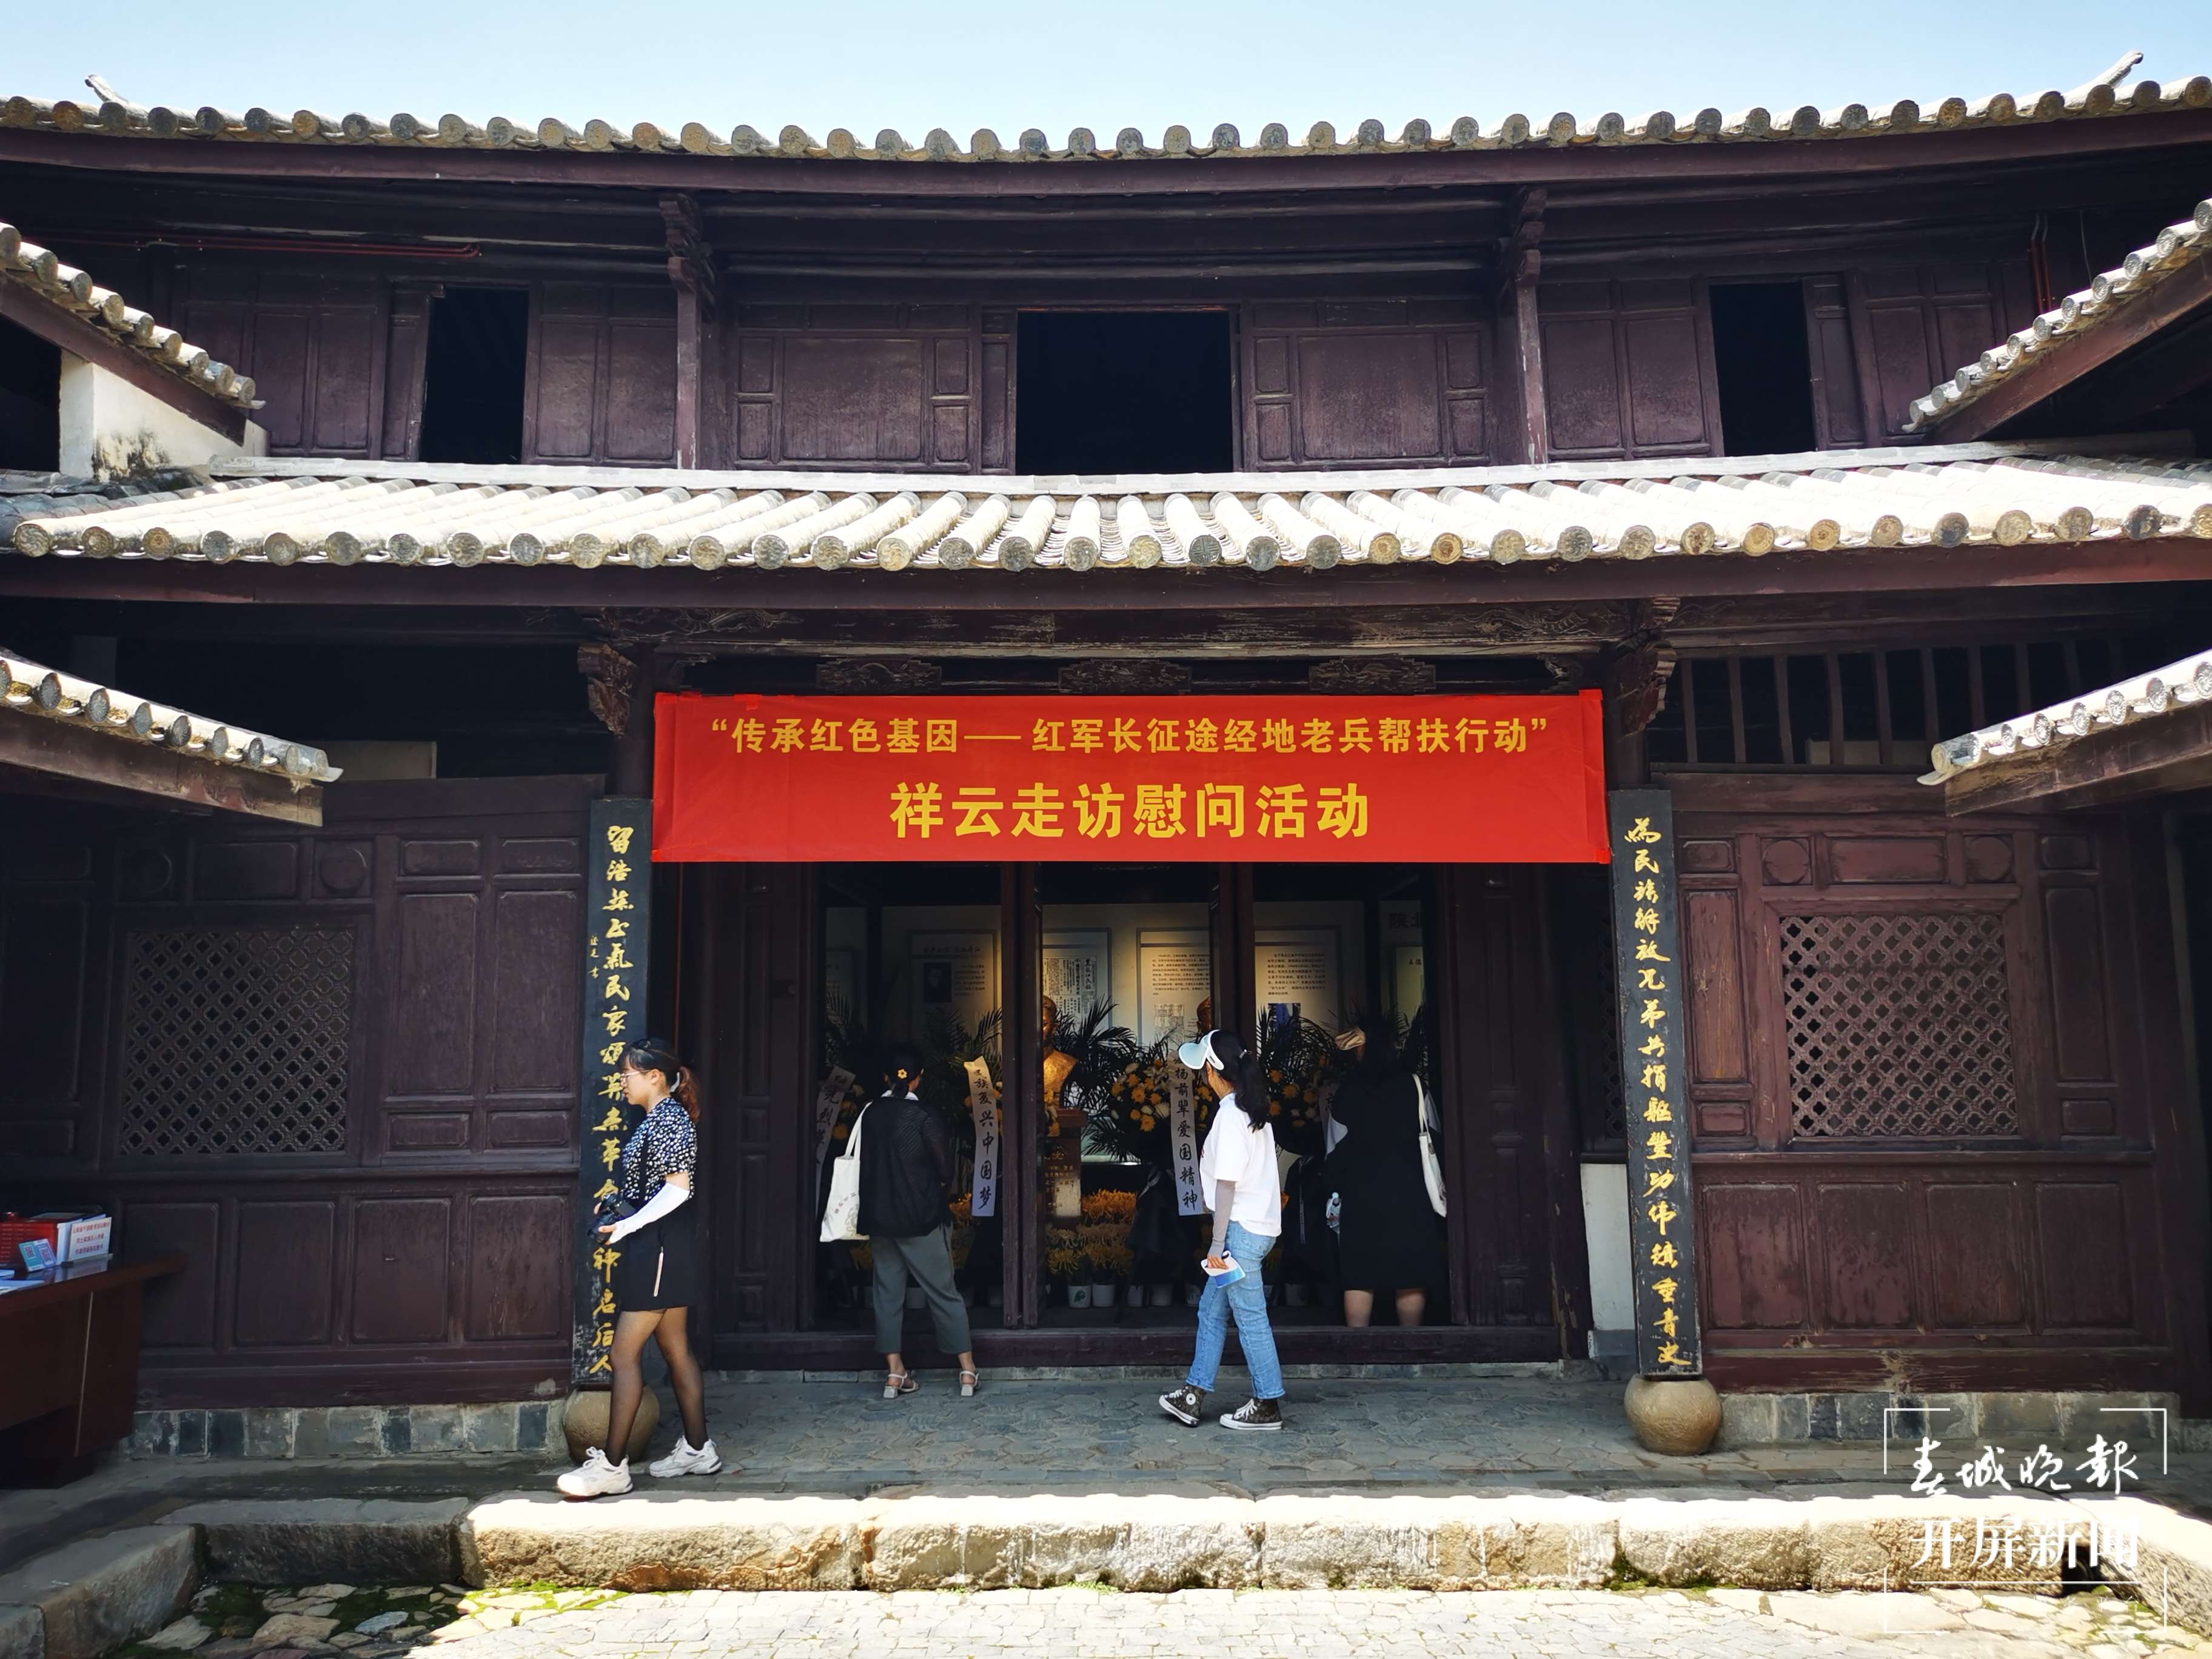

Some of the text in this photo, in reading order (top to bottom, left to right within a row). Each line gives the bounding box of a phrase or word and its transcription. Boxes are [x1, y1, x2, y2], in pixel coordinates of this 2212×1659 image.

[890, 782, 1368, 839] 祥云走访慰问活动
[973, 1069, 995, 1210] 民族复兴中国梦
[1175, 1058, 1198, 1211] 扬前辈爱国精神
